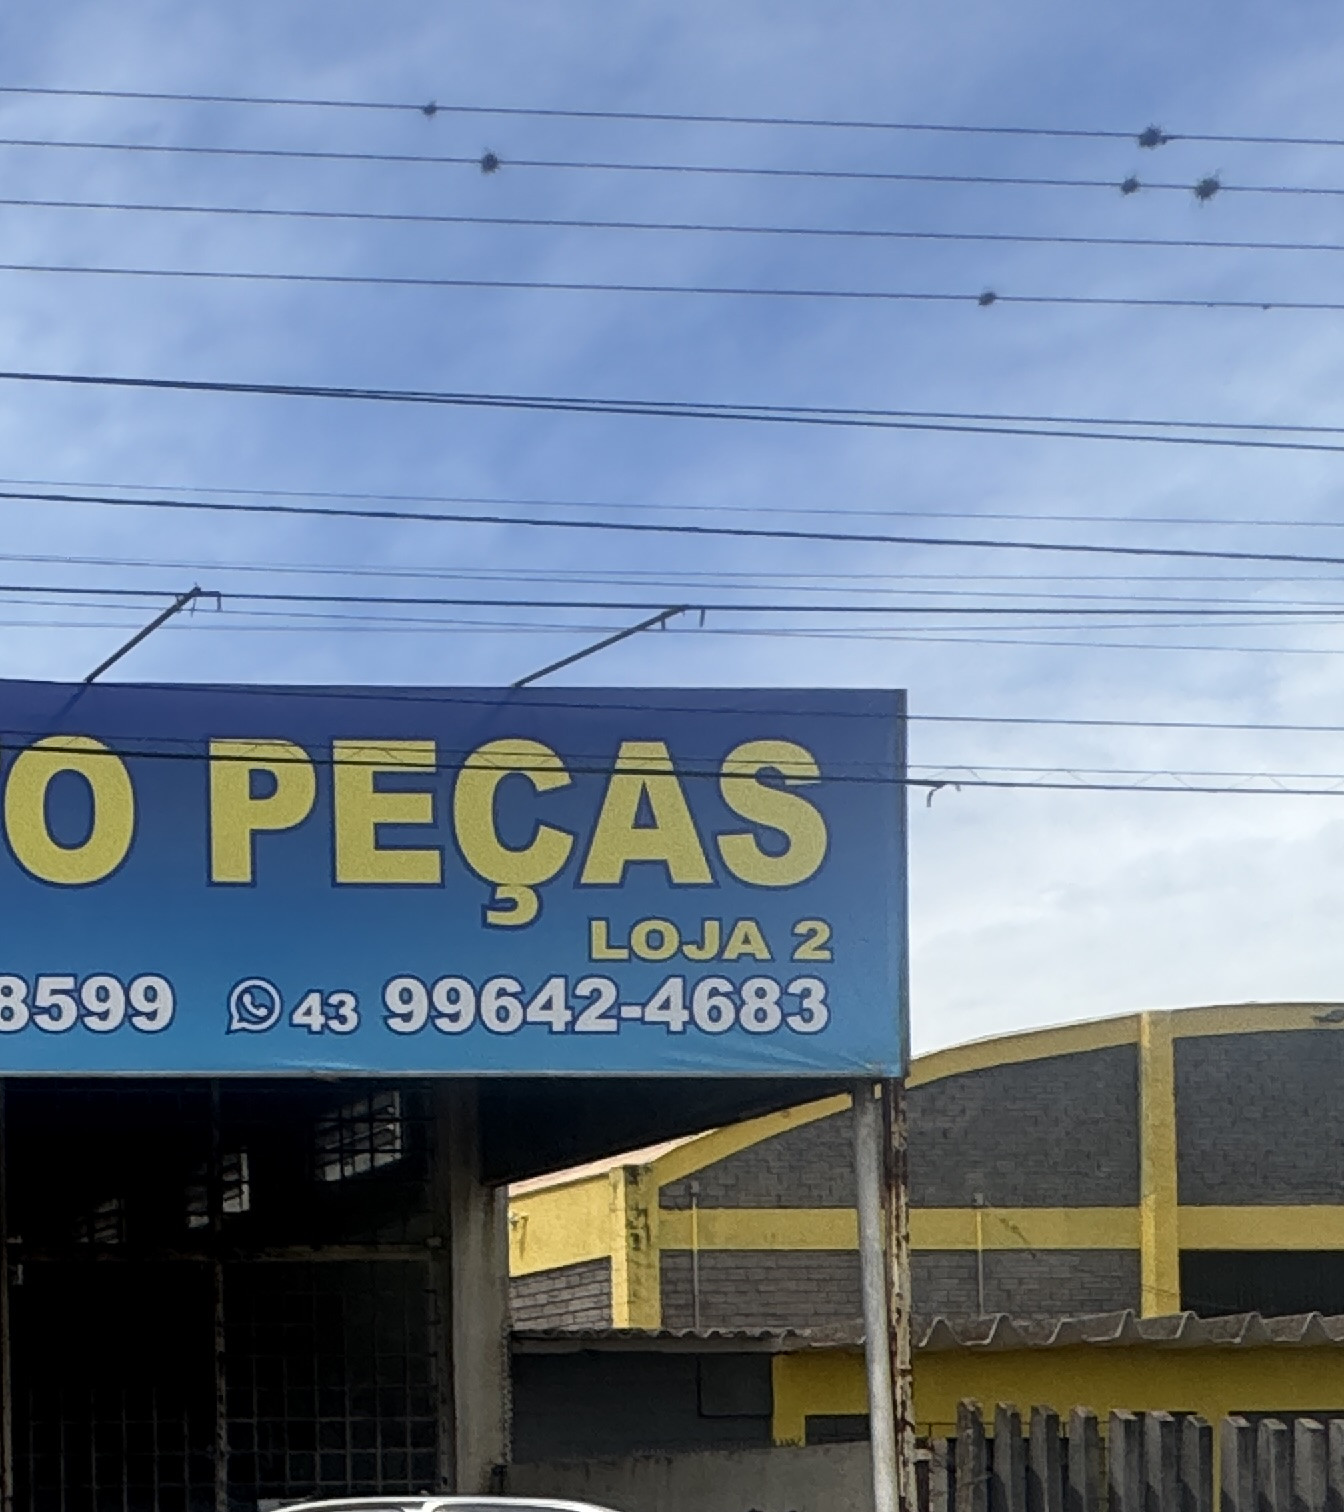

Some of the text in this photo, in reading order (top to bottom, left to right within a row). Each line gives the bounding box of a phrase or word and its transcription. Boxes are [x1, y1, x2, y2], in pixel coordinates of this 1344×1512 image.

[208, 737, 831, 926] PEÇAS
[589, 918, 834, 961] LOJA 2
[292, 976, 830, 1033] 43 99642-4683
